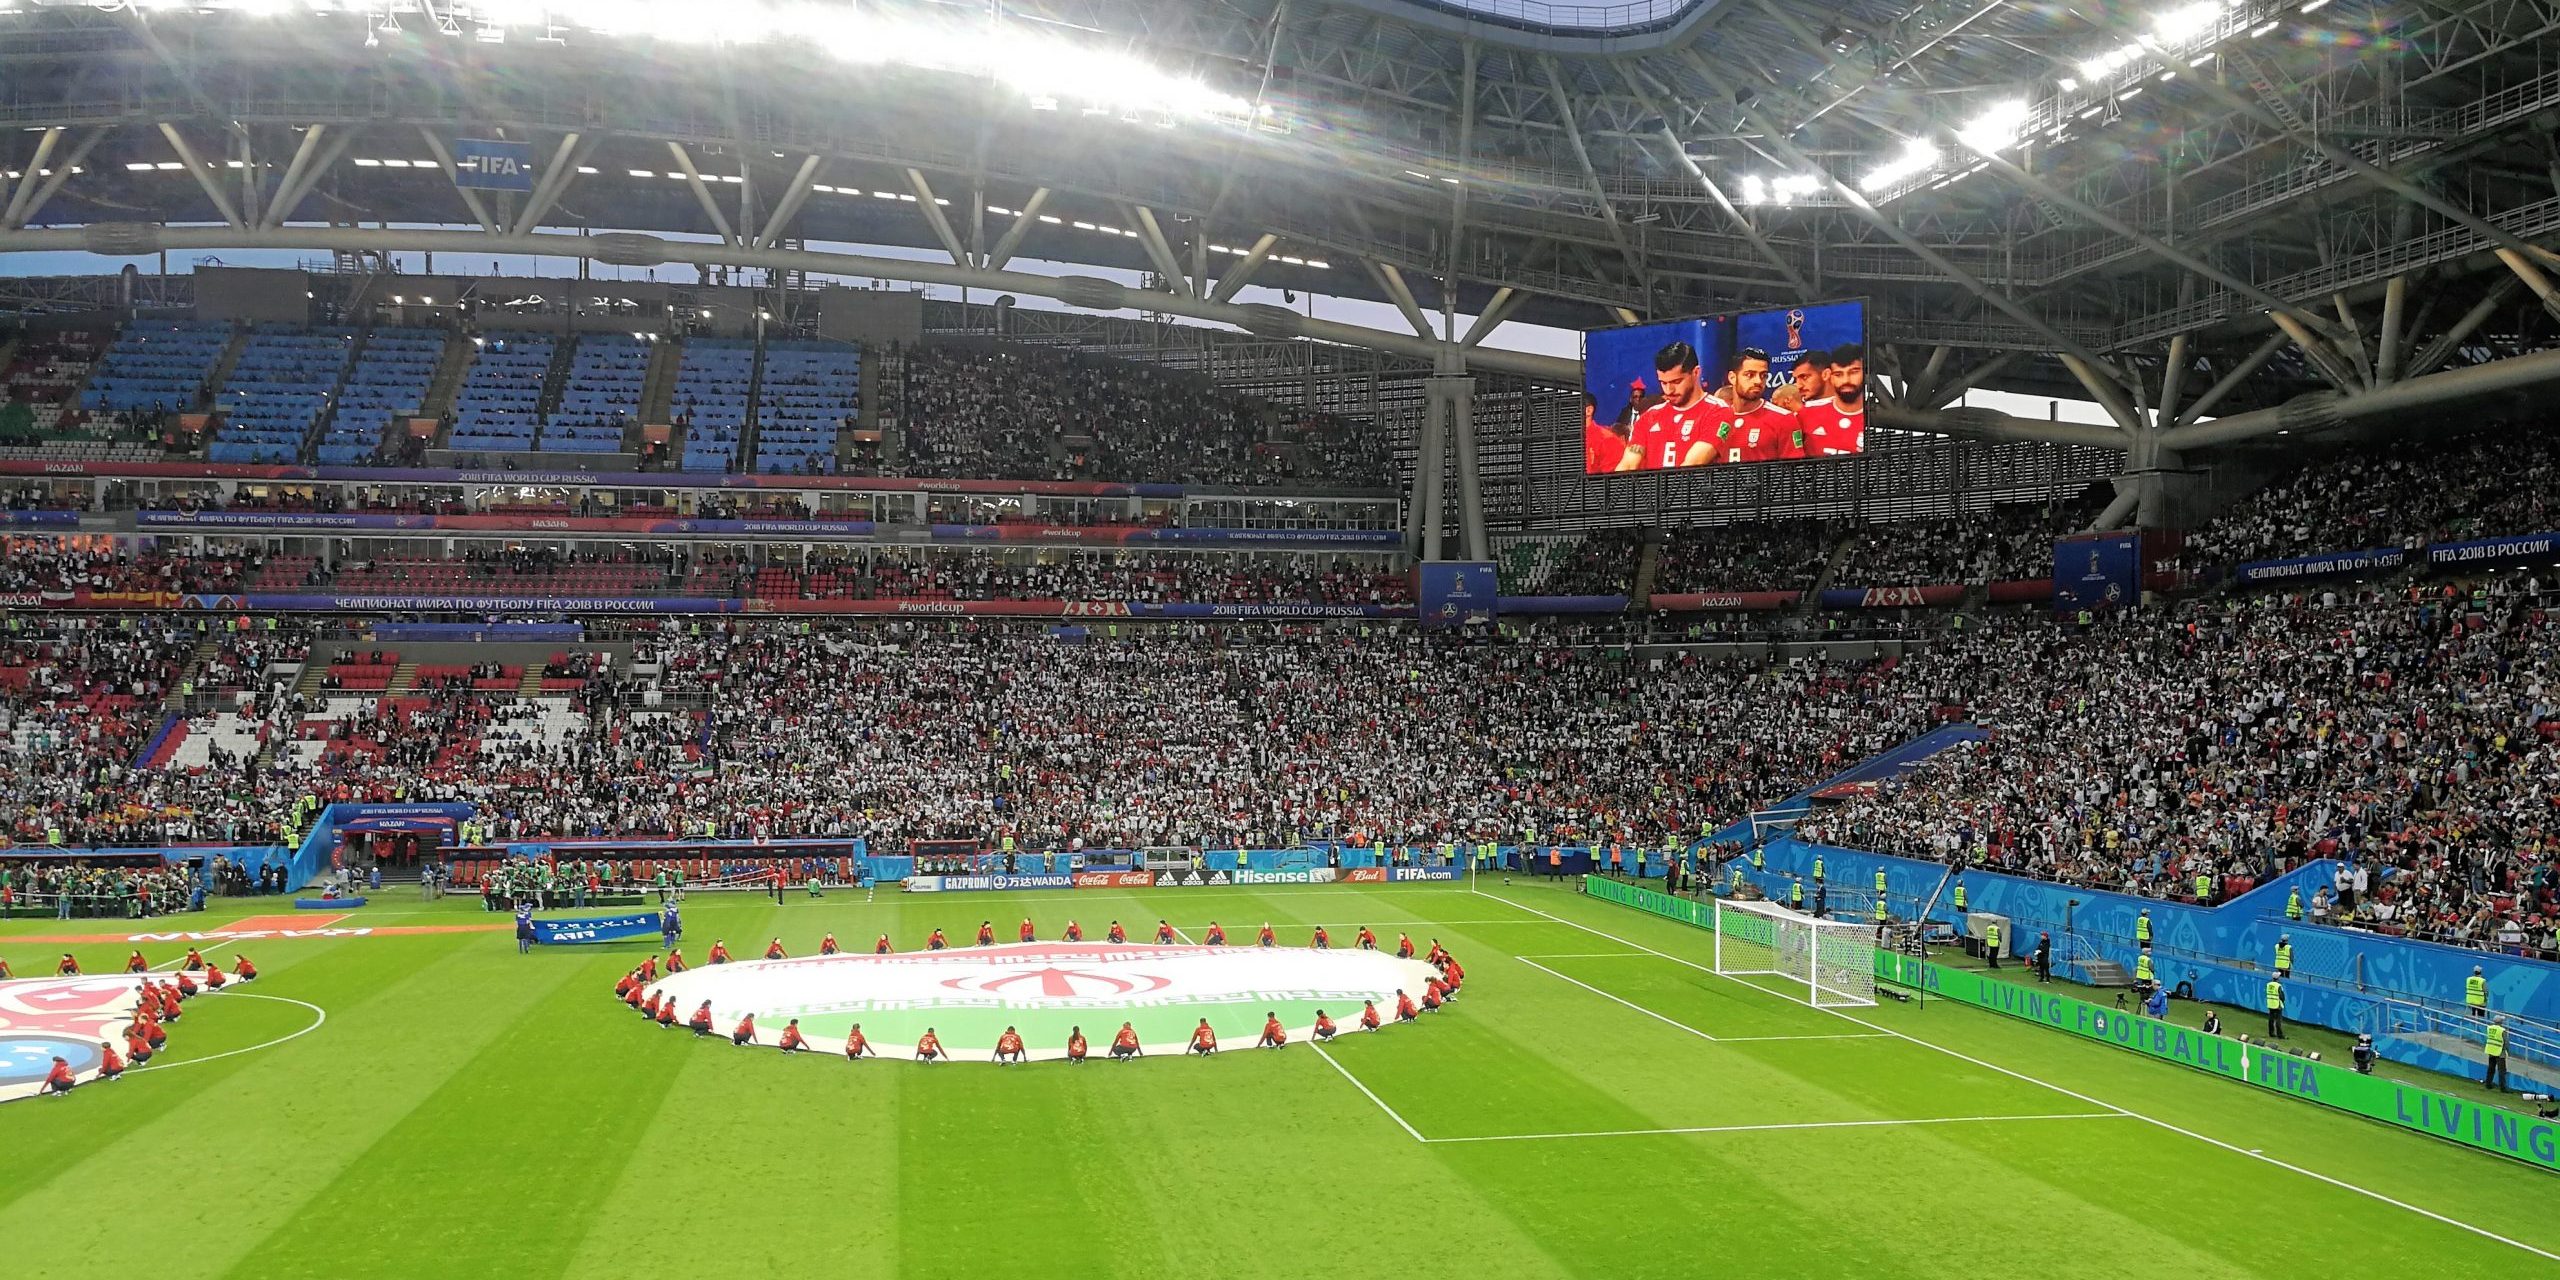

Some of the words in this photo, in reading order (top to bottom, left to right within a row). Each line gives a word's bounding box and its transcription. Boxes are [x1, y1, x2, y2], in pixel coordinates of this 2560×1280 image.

[466, 155, 518, 175] FIFA
[1663, 442, 1676, 468] 6
[45, 463, 84, 473] KAZAN
[459, 472, 480, 481] 2018
[482, 473, 502, 481] FIFA
[504, 473, 538, 482] WORLD
[540, 474, 560, 482] CUP
[562, 474, 597, 483] RUSSIA
[918, 481, 960, 491] #worldcup
[533, 520, 568, 528] КАЗАНЬ
[1042, 528, 1081, 537] #worldcup
[2433, 549, 2456, 562] FIFA
[2459, 547, 2485, 560] 2018
[2488, 545, 2496, 558] В
[2498, 540, 2550, 556] РОССИИ
[2248, 563, 2303, 579] ЧЕМПИОНАТ
[2305, 560, 2335, 574] МИРА
[2338, 559, 2353, 571] ПО
[335, 598, 412, 609] ЧЕМПИОНАТ
[416, 599, 452, 609] МИРА
[455, 600, 473, 609] ПО
[476, 600, 533, 609] ФУТБОЛУ
[536, 600, 562, 609] FIFA
[564, 600, 591, 610] 2018
[594, 600, 602, 610] В
[605, 600, 654, 610] РОССИИ
[898, 601, 964, 613] #worldcup
[1702, 597, 1742, 607] KAZAN
[1213, 605, 1237, 615] 2018
[1238, 605, 1260, 615] FIFA
[1262, 606, 1300, 615] WORLD
[1301, 606, 1324, 616] CUP
[1325, 607, 1364, 616] RUSSIA
[1008, 877, 1032, 888] 万达
[1033, 876, 1072, 886] WANDA
[1235, 870, 1308, 883] Hisense
[1353, 870, 1379, 881] Bud
[945, 877, 989, 890] GAZPROM
[1592, 878, 1626, 899] LIVING
[1632, 890, 1689, 919] FOOTBALL
[1700, 907, 1716, 927] FIF
[1906, 962, 1939, 991] FIFA
[1980, 980, 2062, 1024] LIVING
[2078, 1005, 2229, 1071] FOOTBALL
[2261, 1054, 2320, 1097] FIFA
[2397, 1088, 2555, 1162] LIVING
